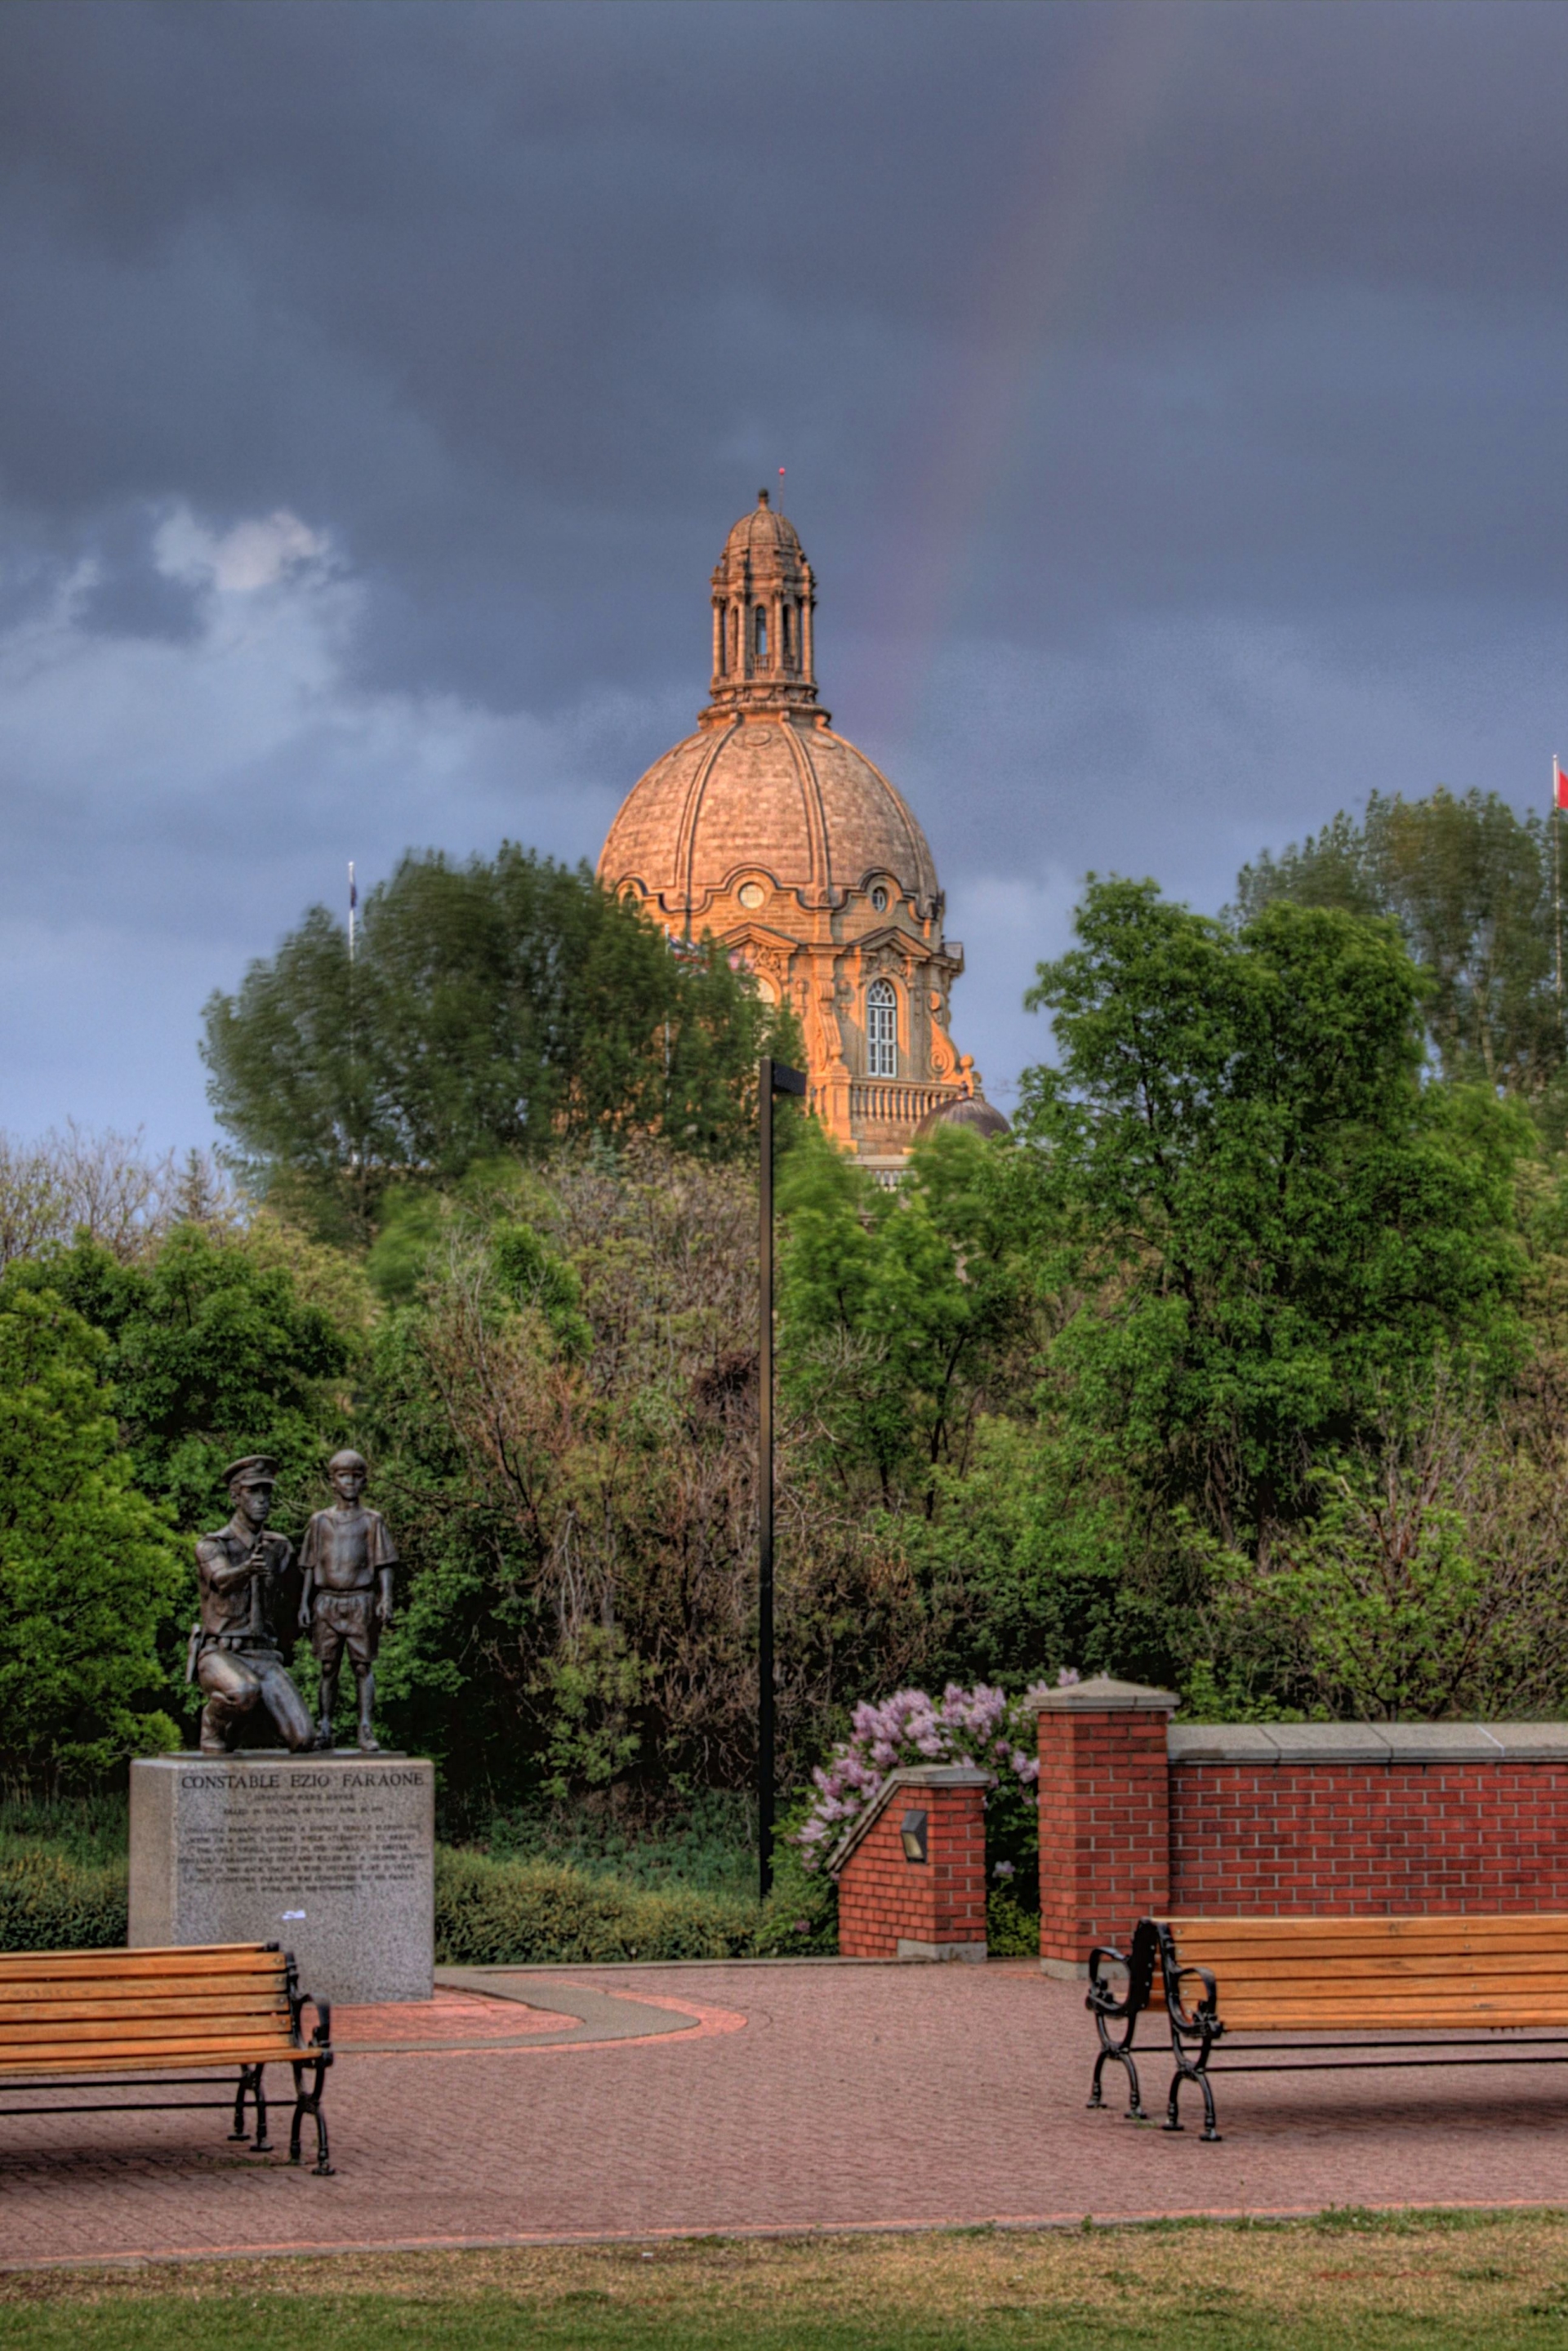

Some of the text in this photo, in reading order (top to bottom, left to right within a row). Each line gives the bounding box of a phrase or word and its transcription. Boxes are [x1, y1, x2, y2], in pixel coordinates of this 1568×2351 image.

[181, 1772, 424, 1789] CONSTABLE EZIO FARAONE
